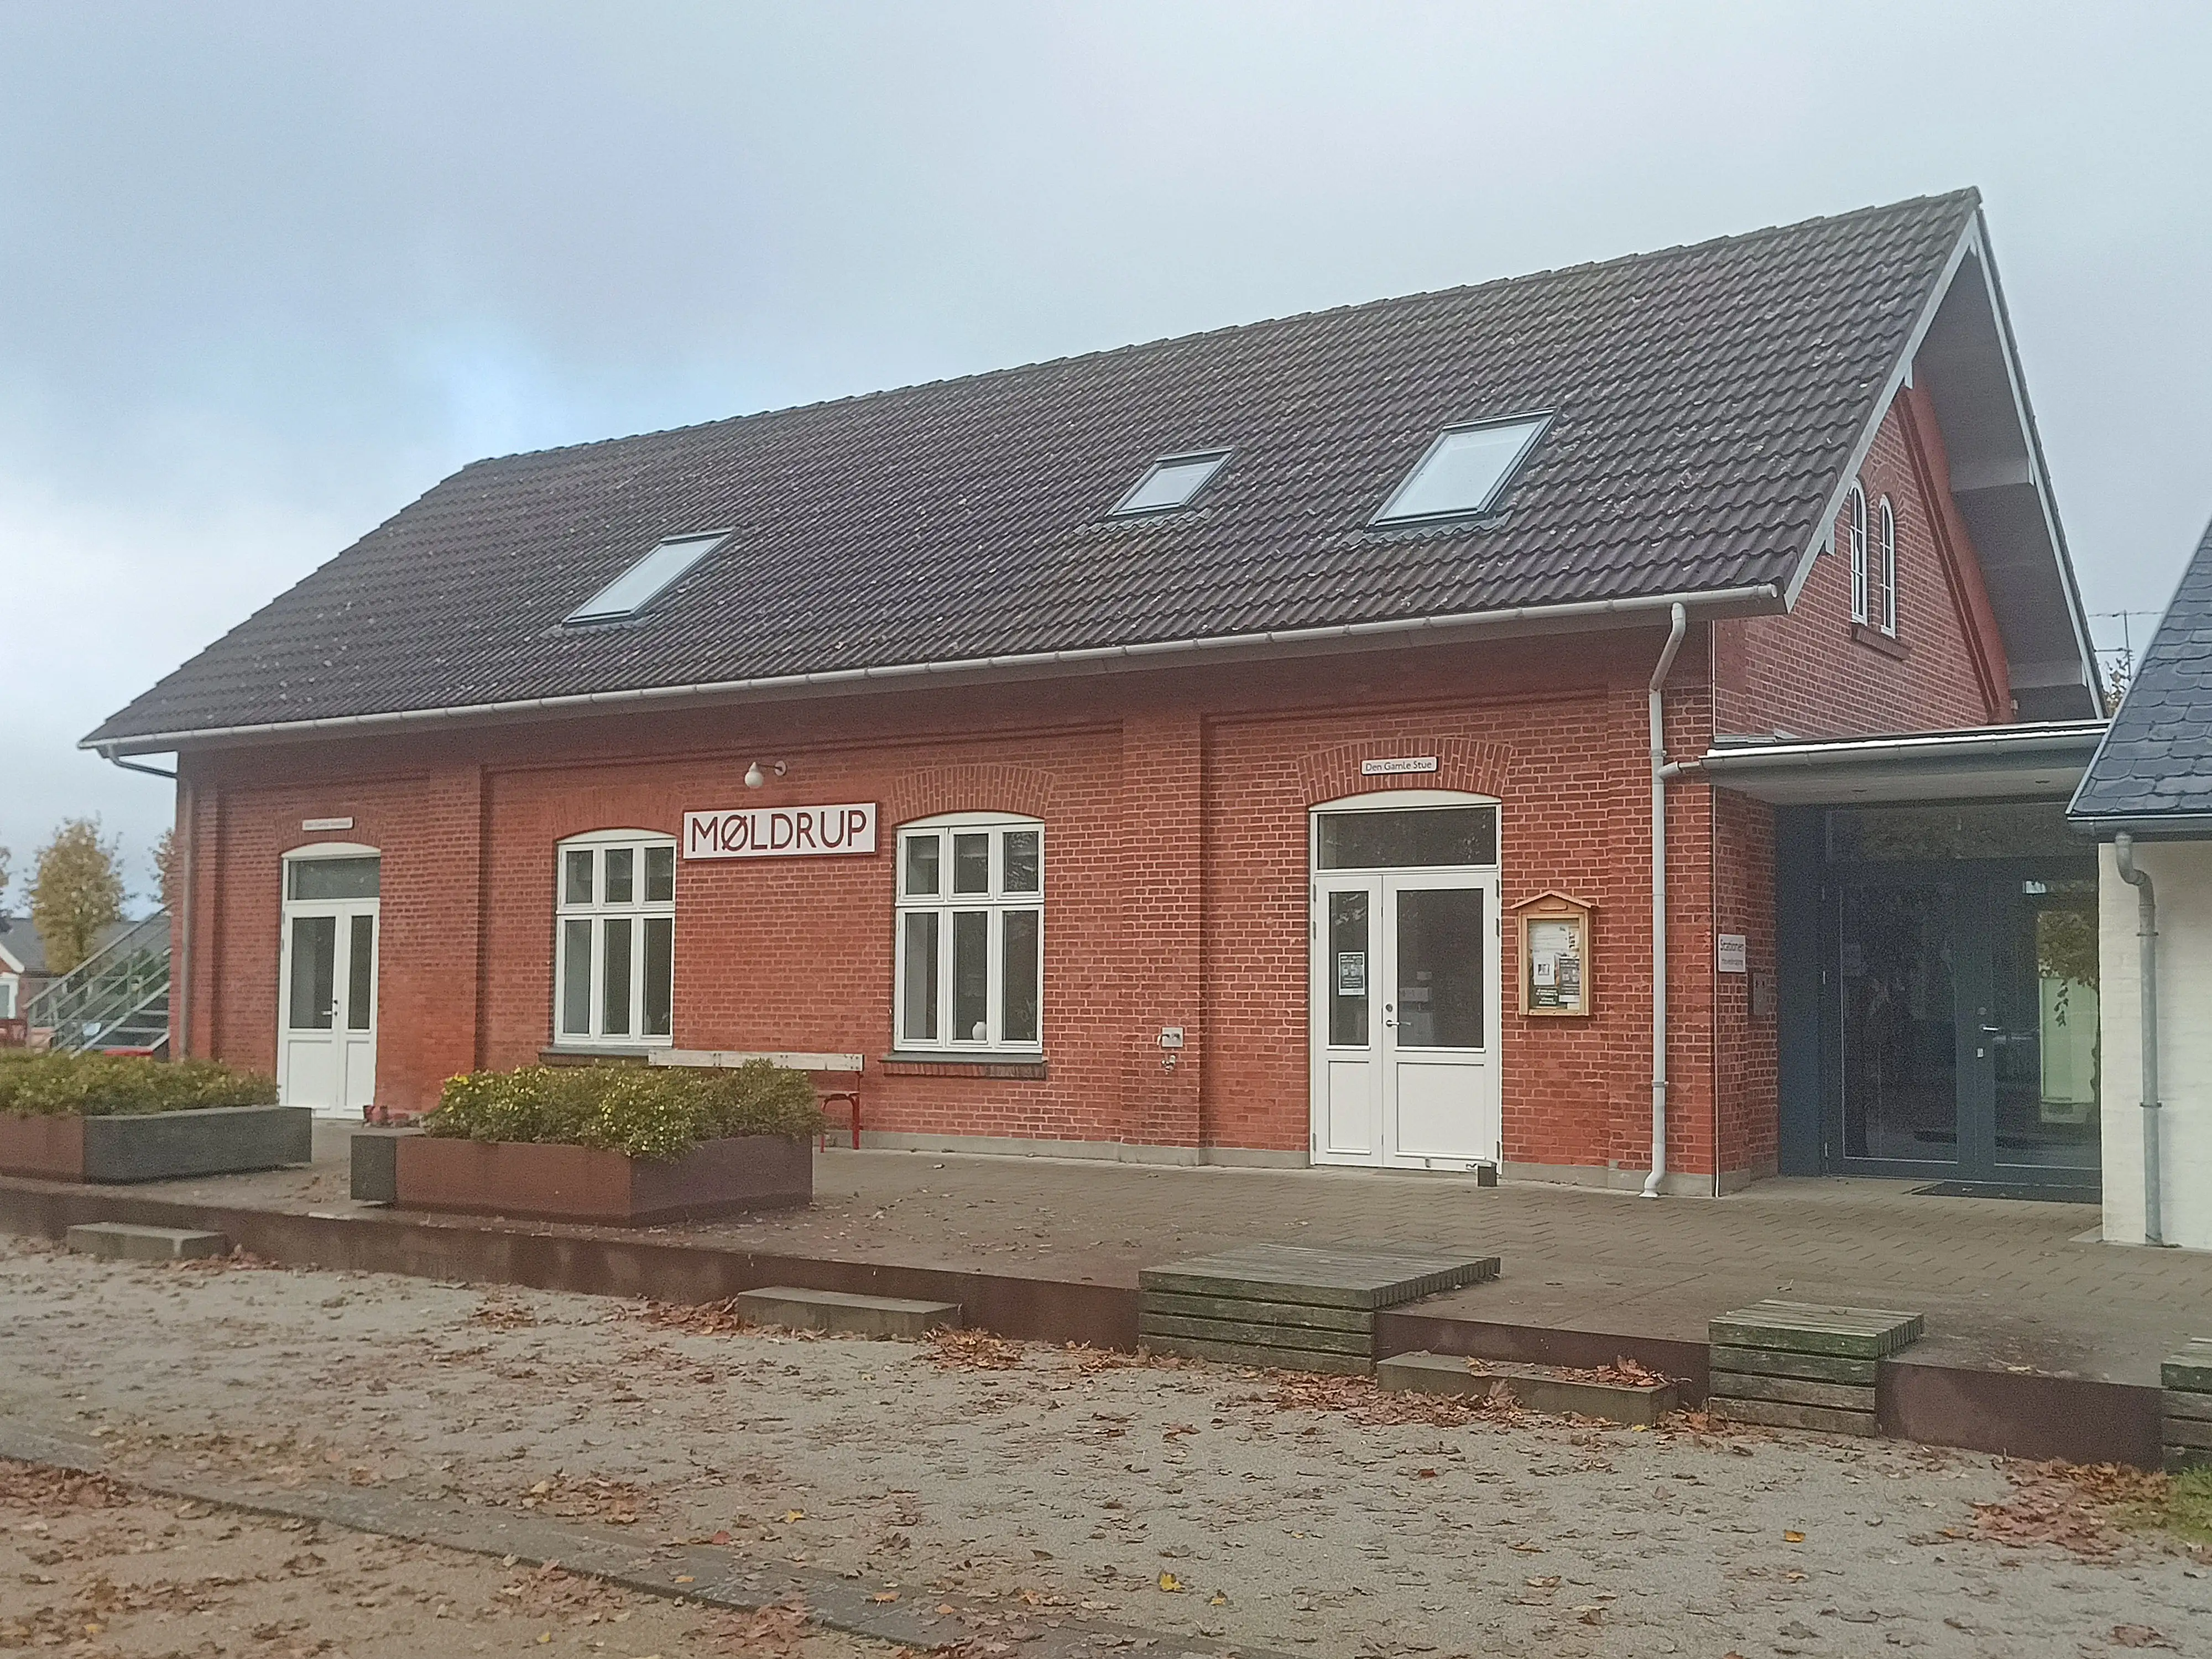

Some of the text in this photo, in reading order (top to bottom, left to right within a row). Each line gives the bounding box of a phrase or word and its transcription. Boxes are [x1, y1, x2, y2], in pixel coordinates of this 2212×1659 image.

[1365, 760, 1432, 771] Den Gamle Stue
[692, 810, 867, 852] MØLDRUP
